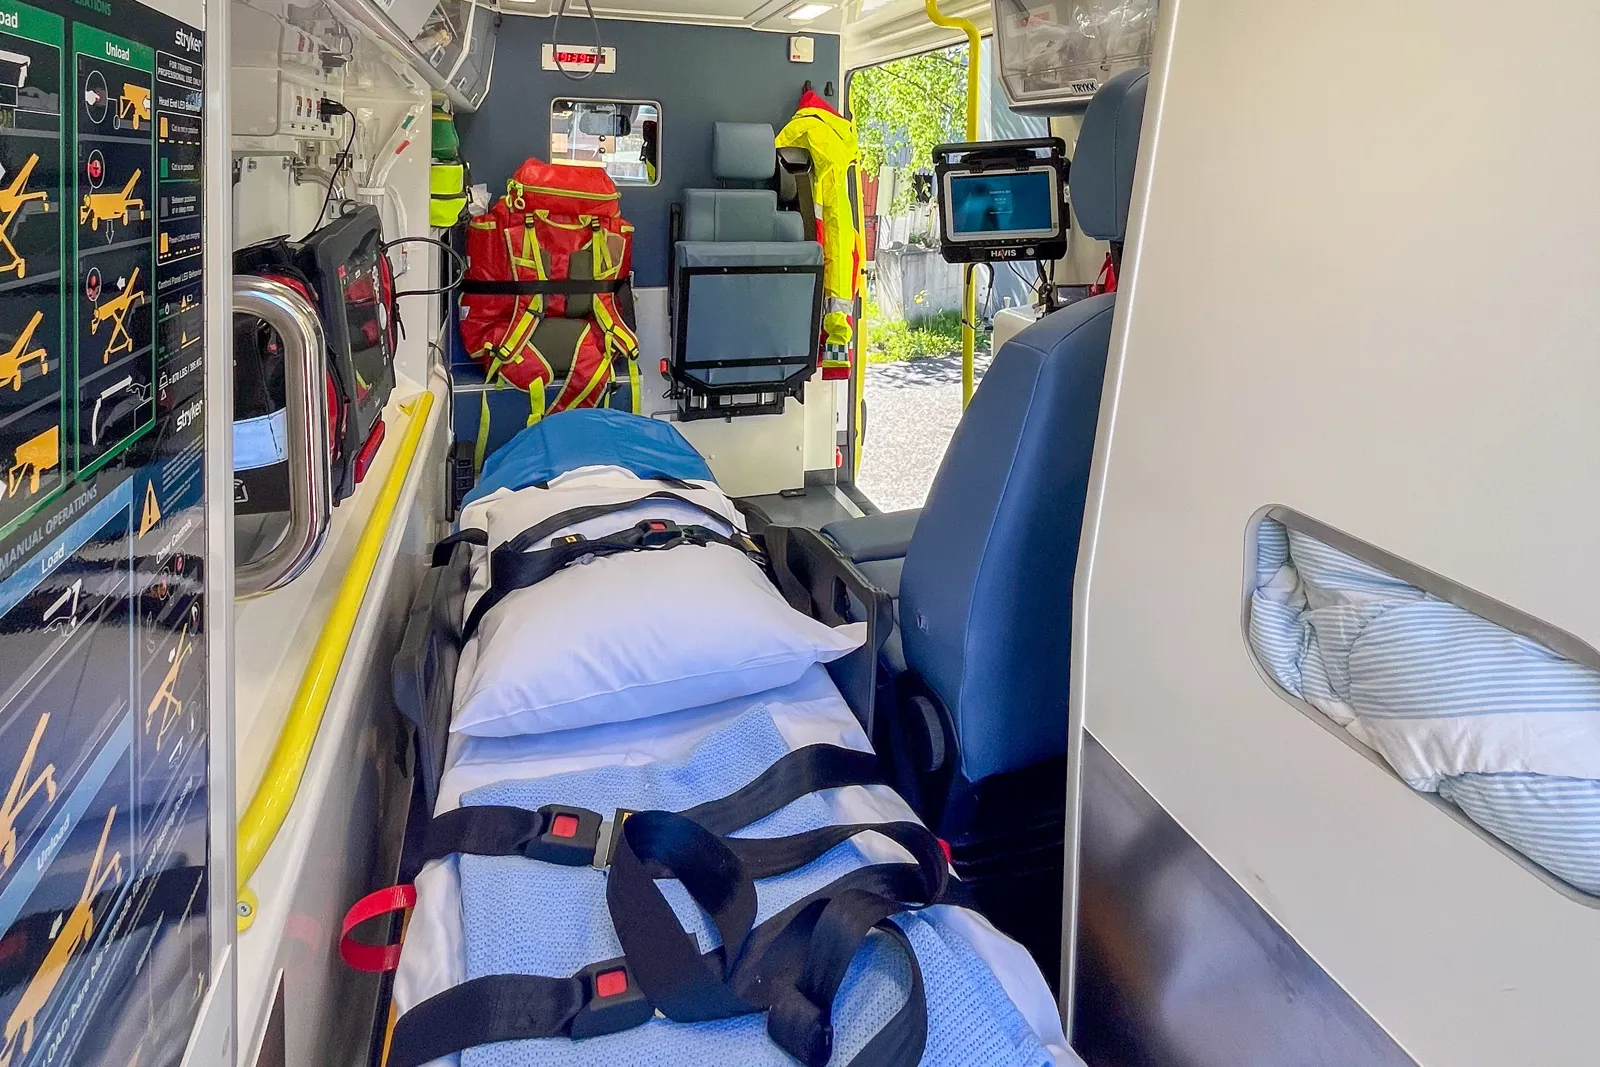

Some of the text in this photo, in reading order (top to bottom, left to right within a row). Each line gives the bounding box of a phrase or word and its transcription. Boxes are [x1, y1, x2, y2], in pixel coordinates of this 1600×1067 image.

[105, 41, 130, 61] Unload
[175, 28, 202, 52] stryker
[177, 62, 192, 74] TRAINED
[1072, 82, 1097, 93] TRYKK
[991, 249, 1017, 258] HAVIS
[176, 400, 203, 433] stryker
[0, 483, 97, 571] MANUAL OPERATIONS
[171, 519, 192, 547] Controls
[41, 542, 65, 574] Load
[36, 812, 70, 871] Unload
